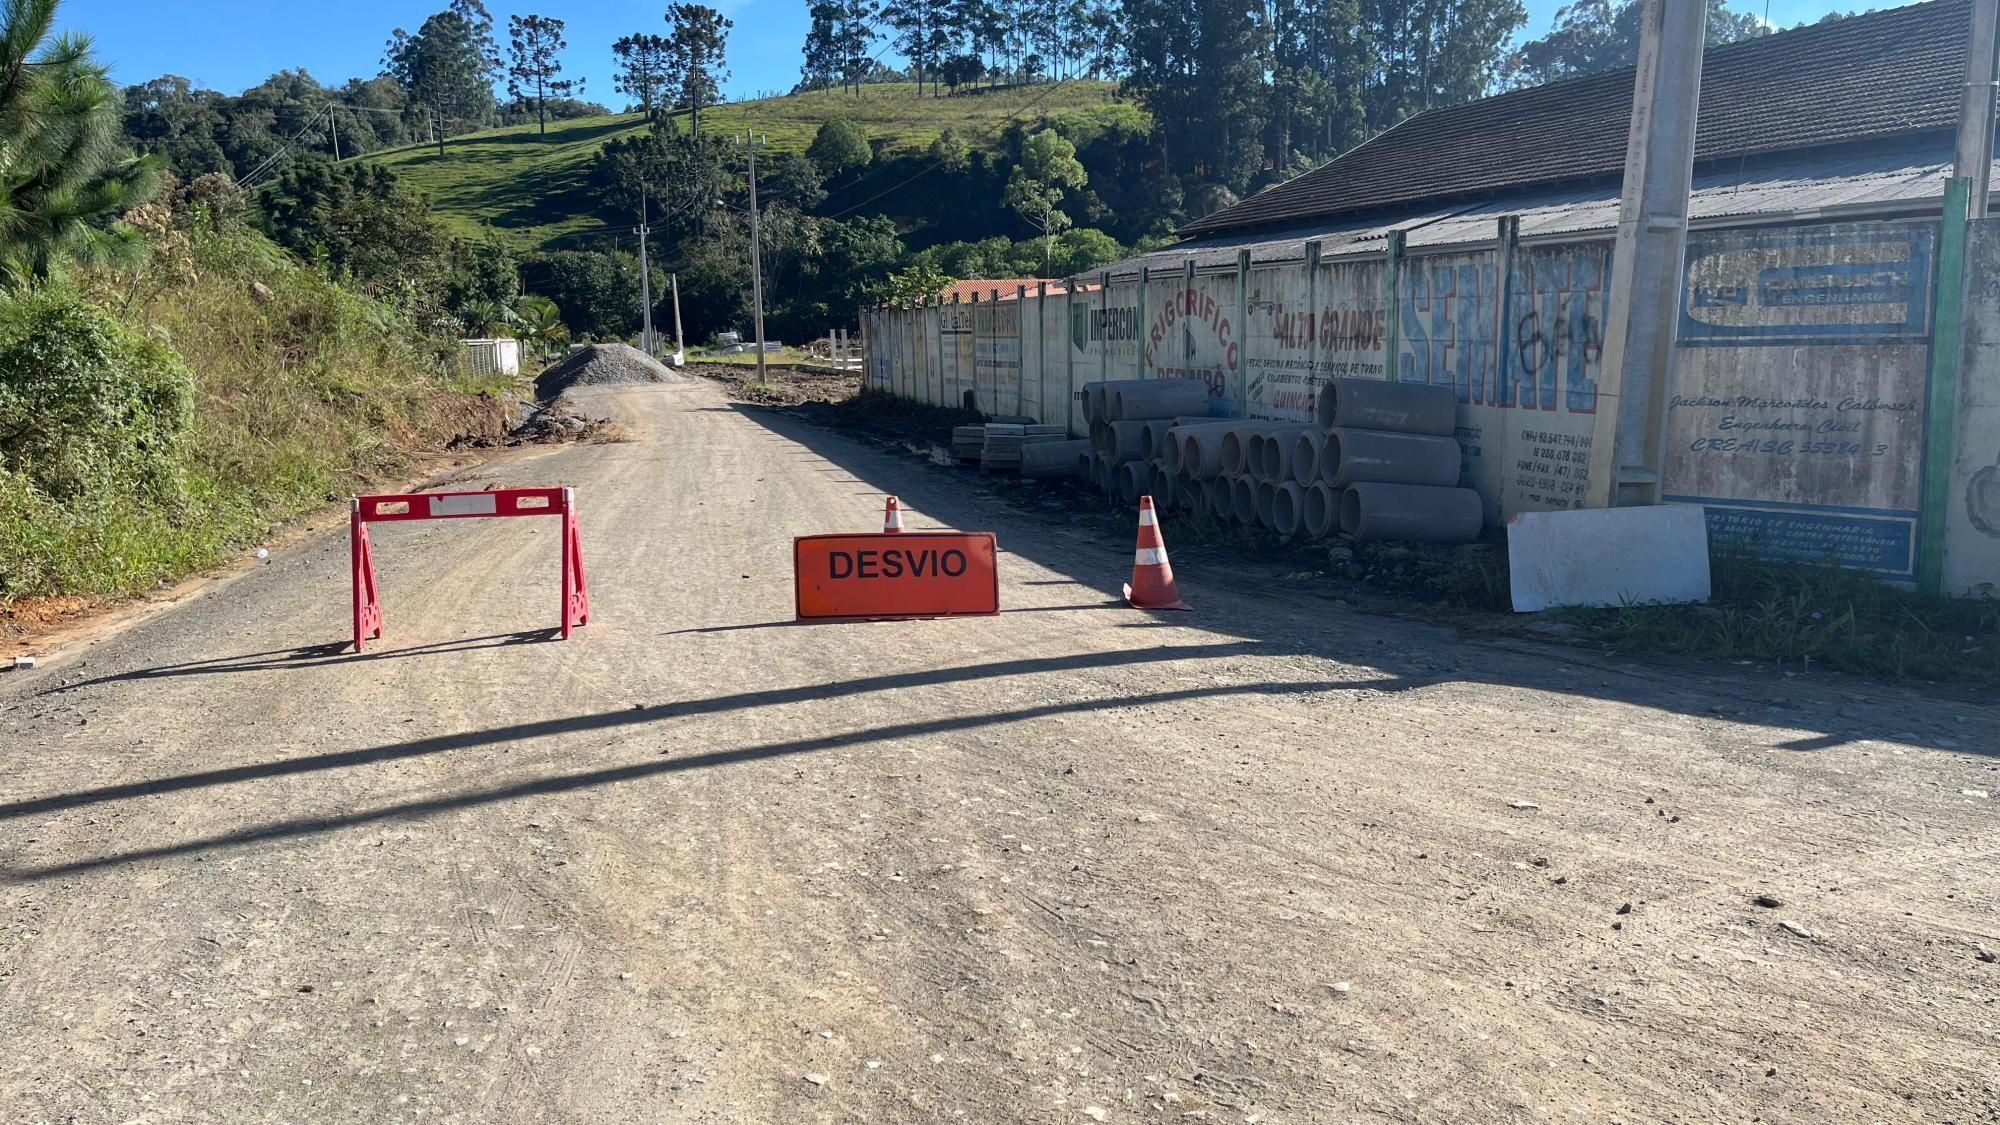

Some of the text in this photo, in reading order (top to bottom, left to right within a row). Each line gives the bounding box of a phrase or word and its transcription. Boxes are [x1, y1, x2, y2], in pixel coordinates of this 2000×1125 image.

[1273, 303, 1386, 352] SALTO GRANDE
[1670, 395, 1729, 410] Jackson
[1736, 396, 1828, 411] Marcondes
[829, 549, 967, 579] DESVIO
